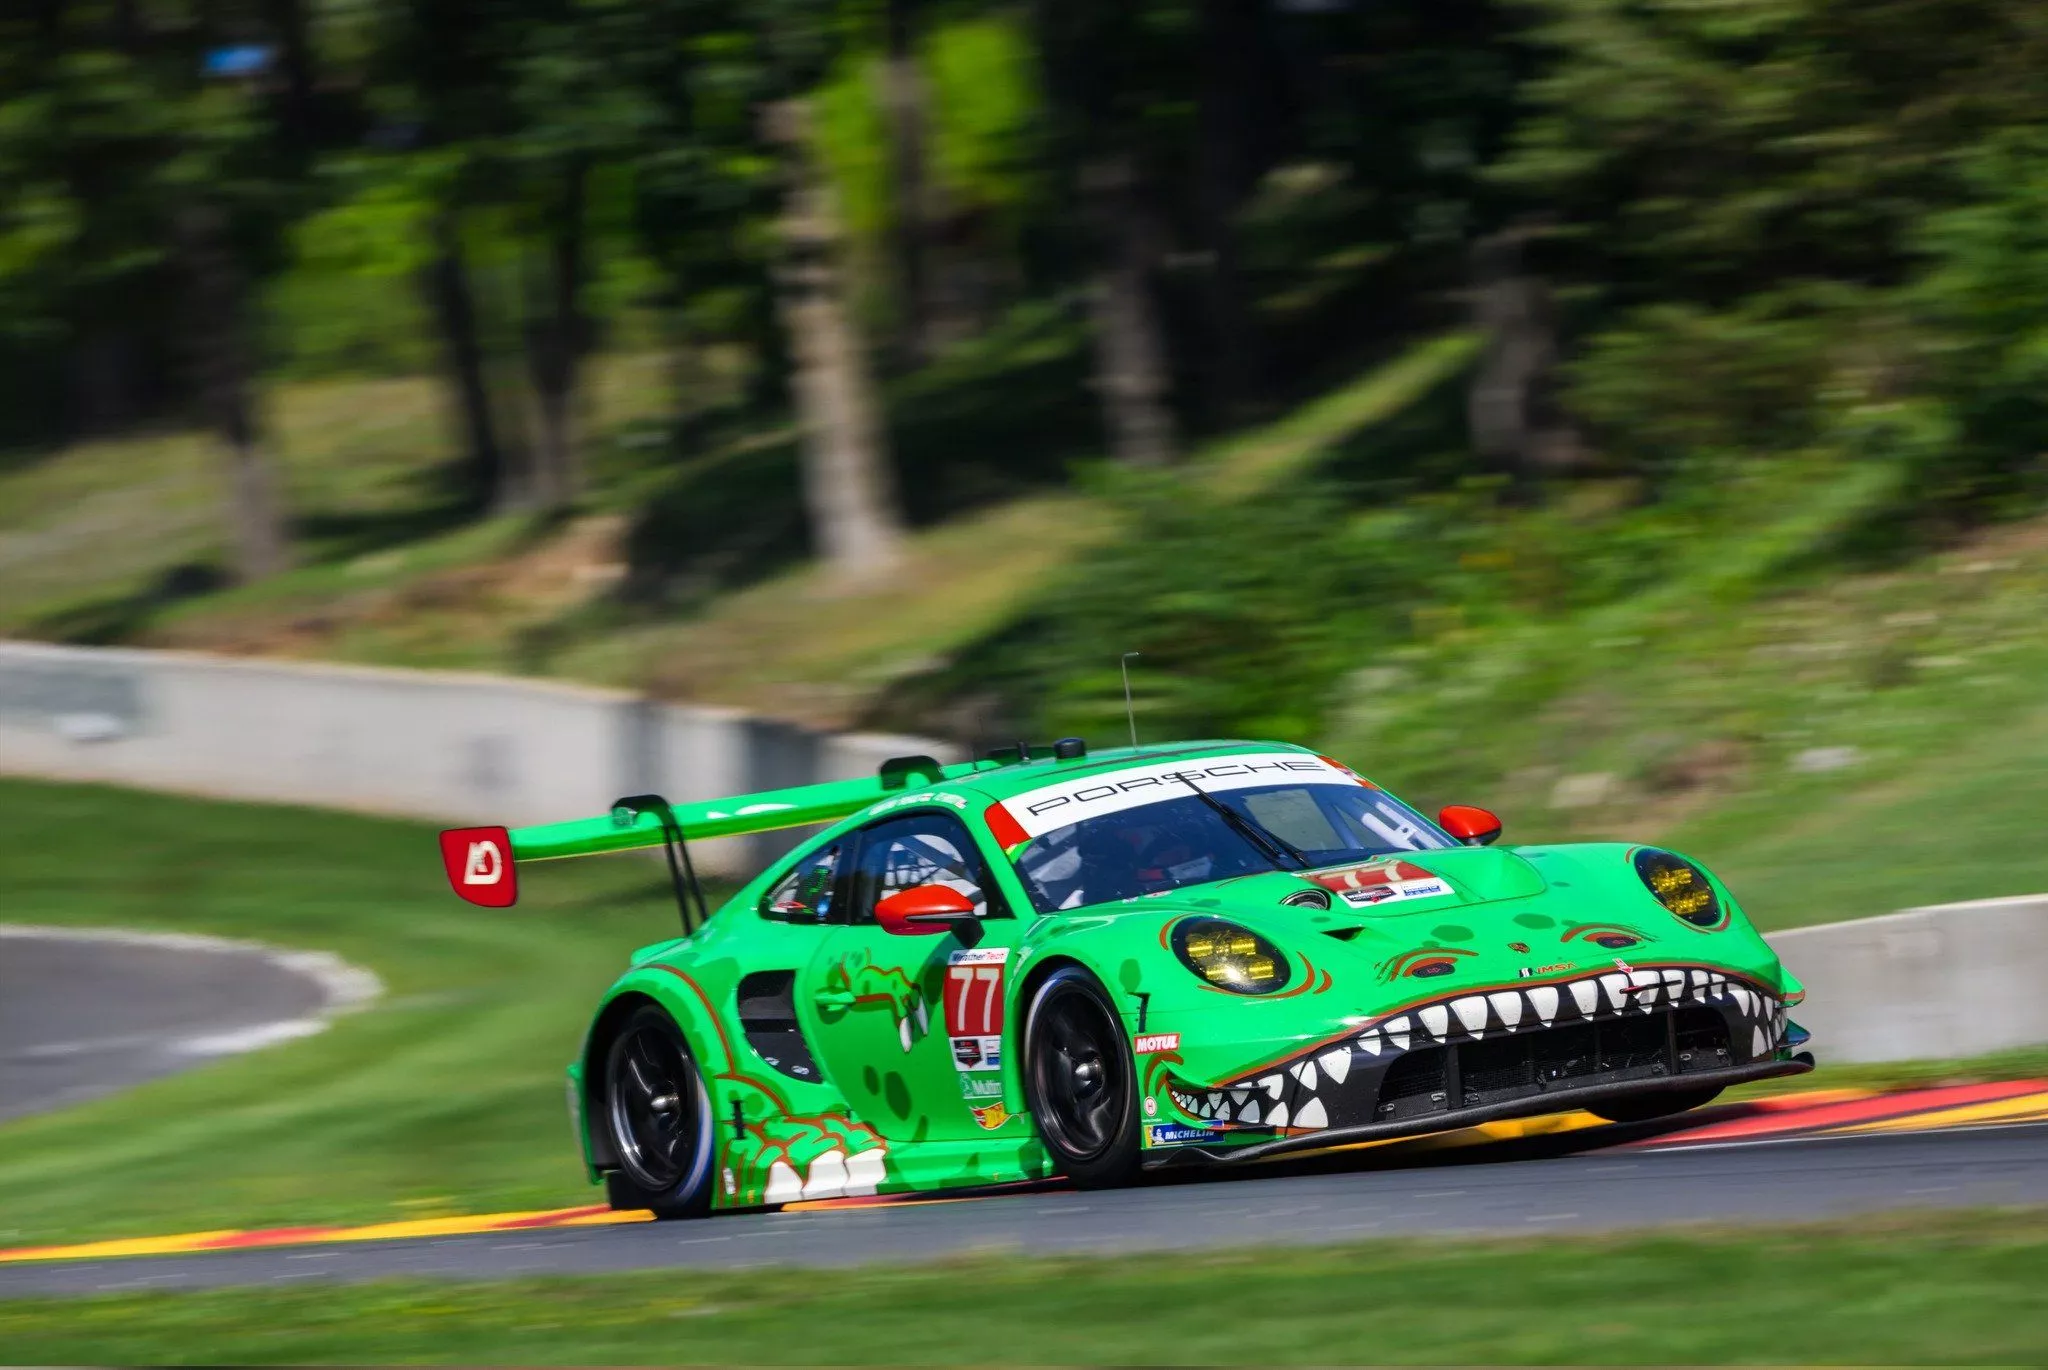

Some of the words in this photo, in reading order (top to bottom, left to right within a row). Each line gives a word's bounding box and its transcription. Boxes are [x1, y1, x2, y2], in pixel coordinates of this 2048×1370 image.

[1026, 760, 1327, 817] PORSCHE
[1536, 961, 1577, 975] IMSA
[950, 966, 1000, 1033] 77
[1136, 1035, 1179, 1053] MOTUL
